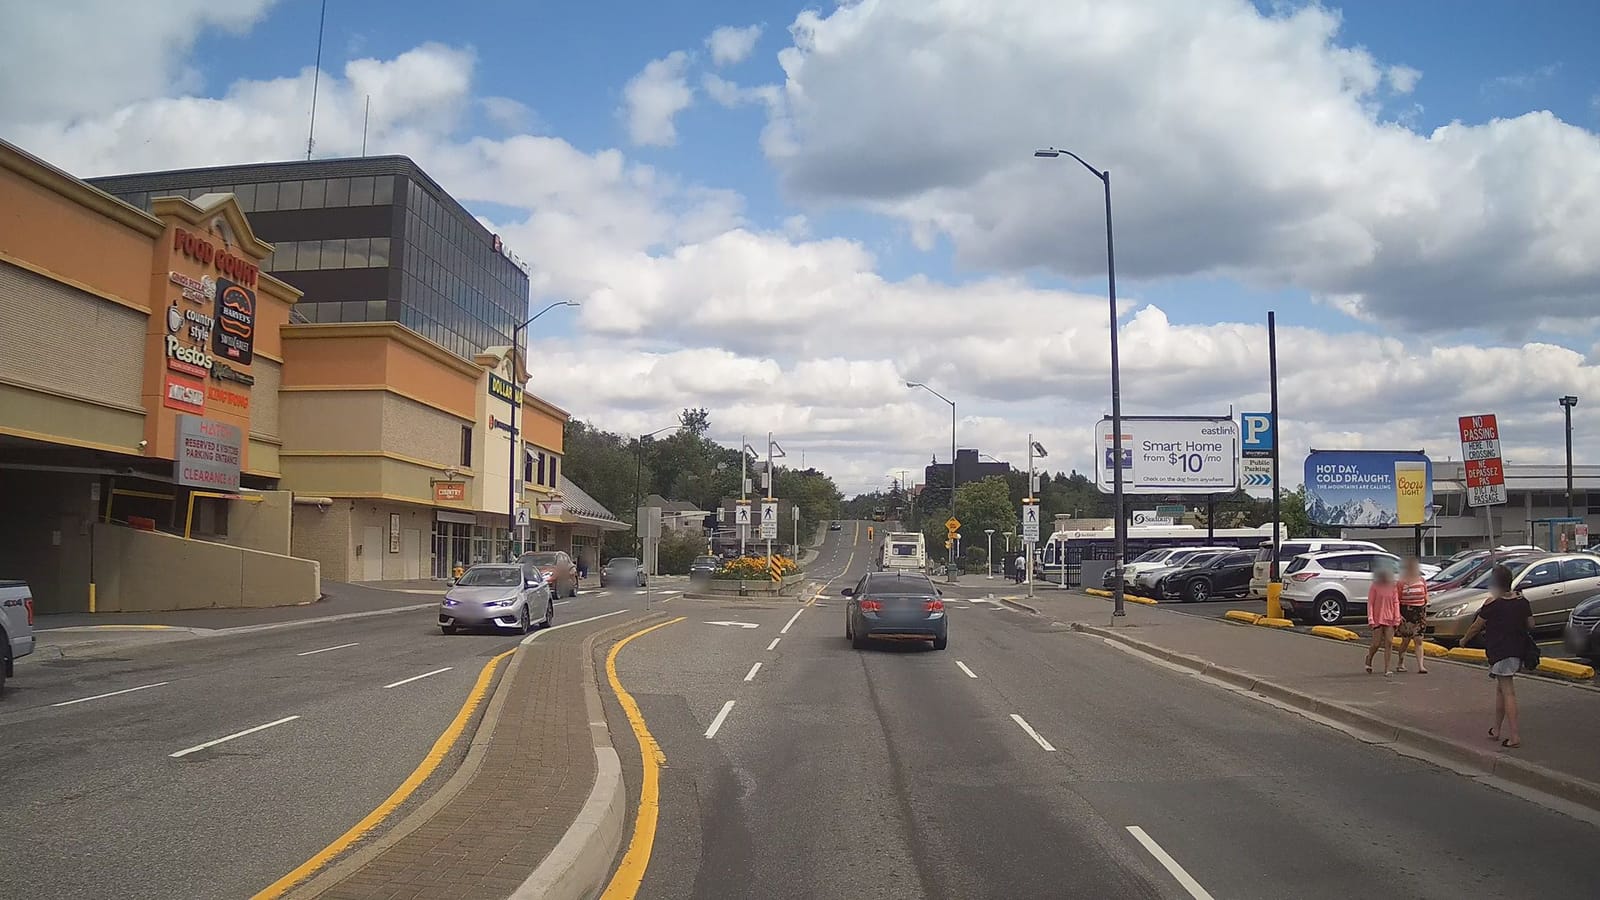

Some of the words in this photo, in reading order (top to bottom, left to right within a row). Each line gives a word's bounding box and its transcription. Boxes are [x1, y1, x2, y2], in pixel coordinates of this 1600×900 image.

[174, 227, 214, 264] FOOD
[214, 249, 258, 286] COURT
[186, 309, 215, 329] country
[223, 306, 251, 324] HARVEY'S
[190, 325, 209, 341] style
[1472, 416, 1483, 428] NO
[1201, 426, 1235, 435] eastlink
[1245, 416, 1270, 443] P
[1463, 427, 1495, 442] PASSING
[185, 438, 215, 451] RESERVED
[1142, 440, 1182, 452] Smart
[1185, 441, 1222, 452] Home
[1468, 441, 1482, 450] HERE
[1486, 440, 1494, 448] TO
[186, 448, 214, 460] PARKING
[215, 453, 238, 465] ENTRANCE
[1143, 454, 1165, 462] from
[1469, 449, 1496, 460] CROSSING
[1316, 464, 1337, 474] HOT
[1338, 464, 1360, 475] DAY,
[1478, 460, 1487, 468] NE
[184, 468, 226, 484] CLEARANCE
[1469, 467, 1498, 478] DEPASSEZ
[1176, 476, 1186, 484] dog
[1316, 474, 1343, 483] COLD
[1344, 474, 1391, 483] DRAUGHT.
[1479, 477, 1490, 486] PAS
[1474, 493, 1499, 503] PASSAGE
